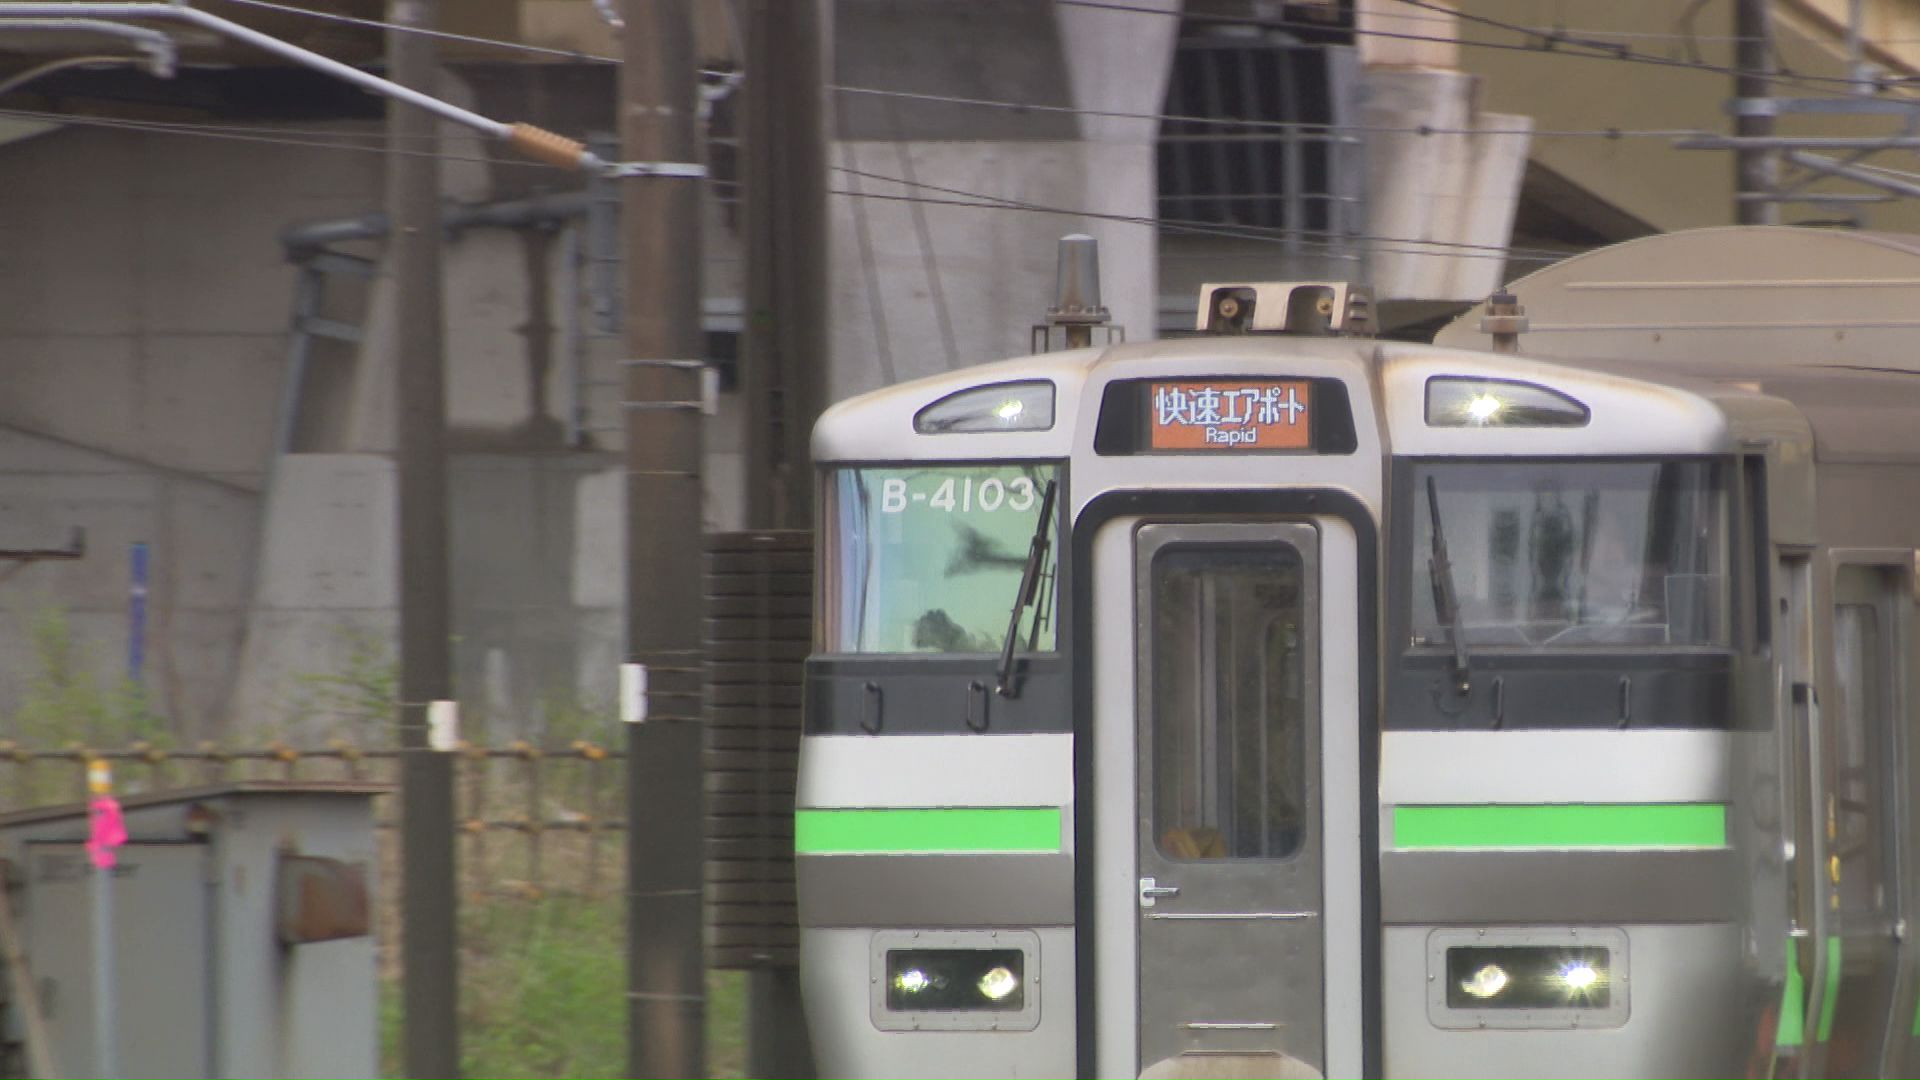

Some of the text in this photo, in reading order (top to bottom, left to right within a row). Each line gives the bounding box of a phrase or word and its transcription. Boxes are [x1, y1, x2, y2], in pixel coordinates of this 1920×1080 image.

[1156, 387, 1304, 424] 快速エアポート
[1206, 427, 1256, 446] Rapid
[882, 477, 1034, 512] B-4103
